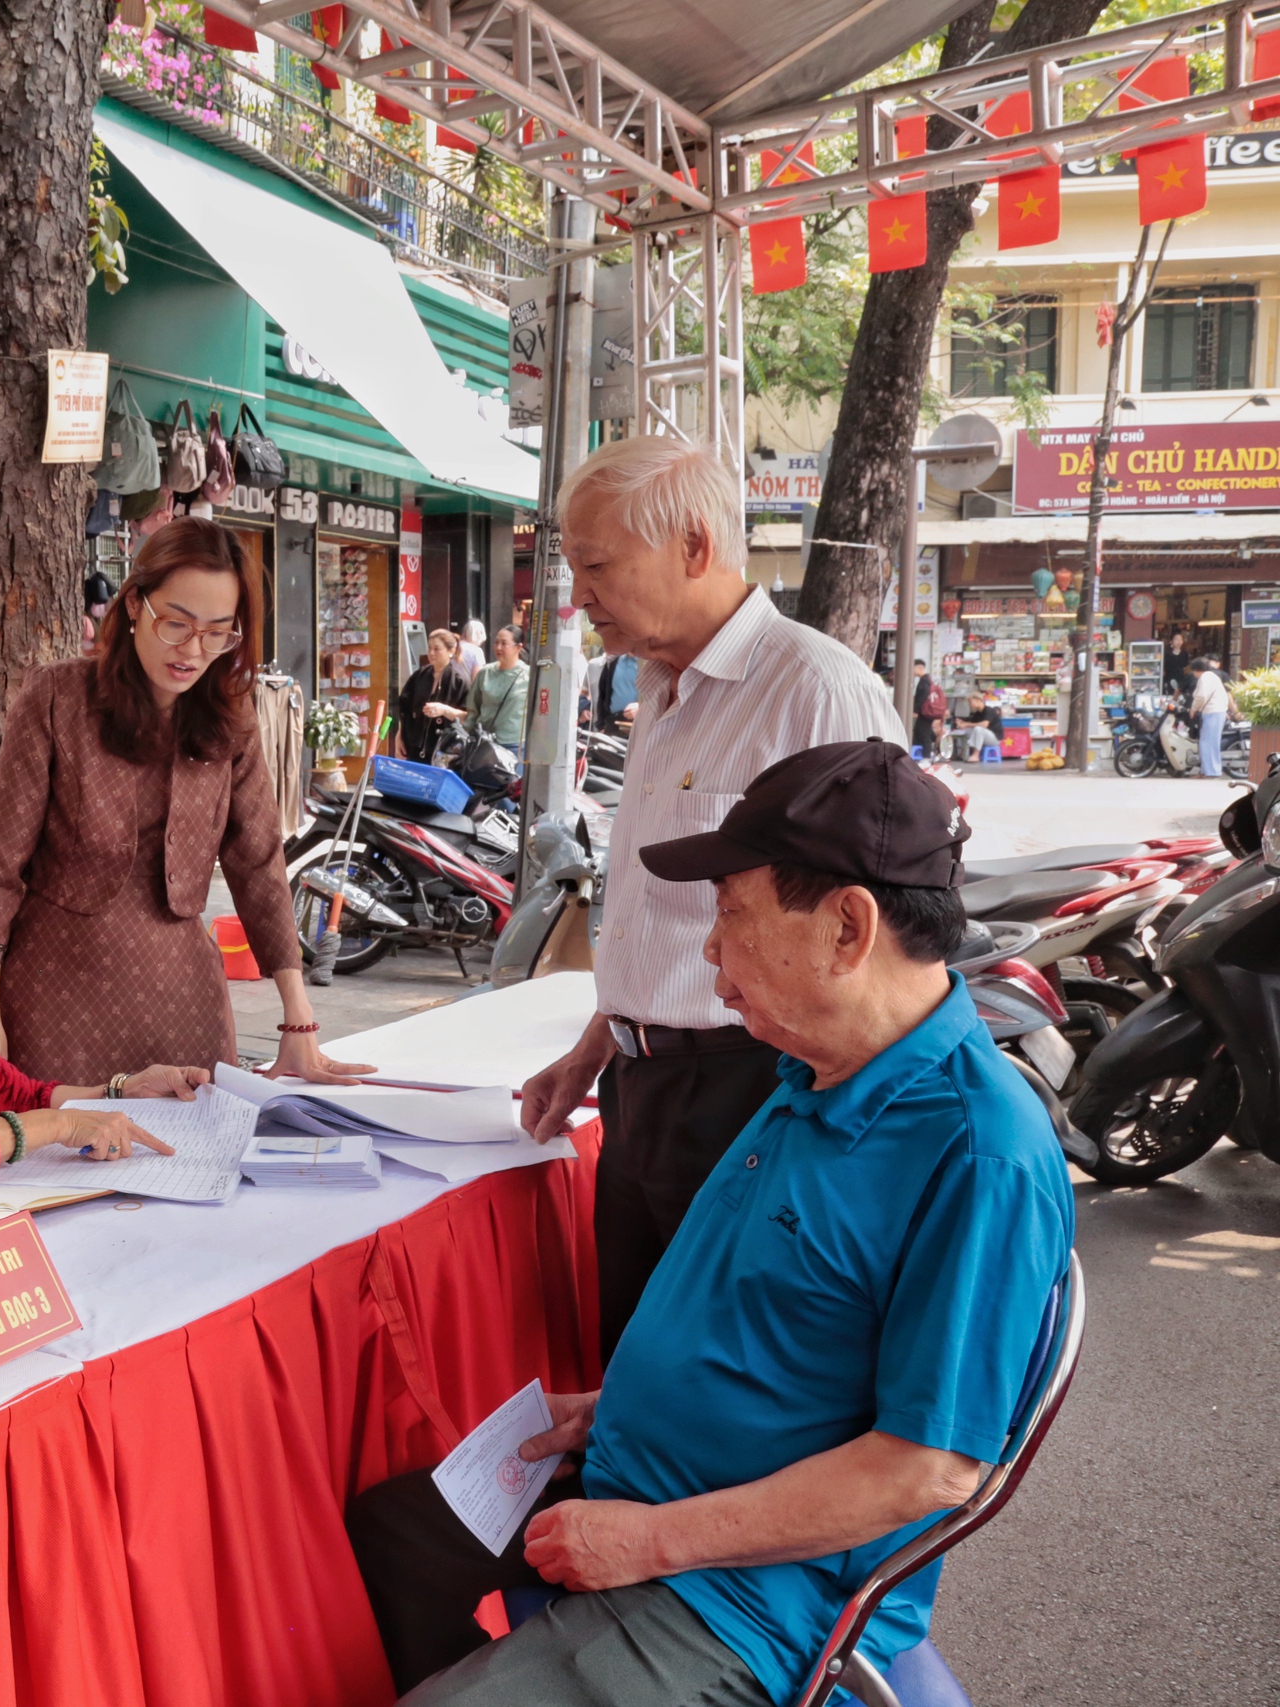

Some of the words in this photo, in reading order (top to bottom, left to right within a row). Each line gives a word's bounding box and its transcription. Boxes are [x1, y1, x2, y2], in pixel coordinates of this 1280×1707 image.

[509, 301, 535, 318] KURT
[514, 311, 539, 328] HERE
[1040, 434, 1064, 445] HTX
[1065, 433, 1091, 445] MAY
[1120, 428, 1146, 444] CHỦ
[1127, 441, 1186, 475] CHỦ
[747, 470, 789, 502] NỘM
[795, 476, 821, 497] TH
[1136, 479, 1162, 492] TEA
[280, 486, 319, 524] 53
[1110, 494, 1138, 506] HOÀNG
[1145, 493, 1169, 505] HOÀN
[1197, 492, 1211, 504] HÀ
[1211, 492, 1226, 505] NỘI
[327, 501, 396, 535] POSTER
[0, 1290, 40, 1330] BẠC
[34, 1286, 52, 1314] 3
